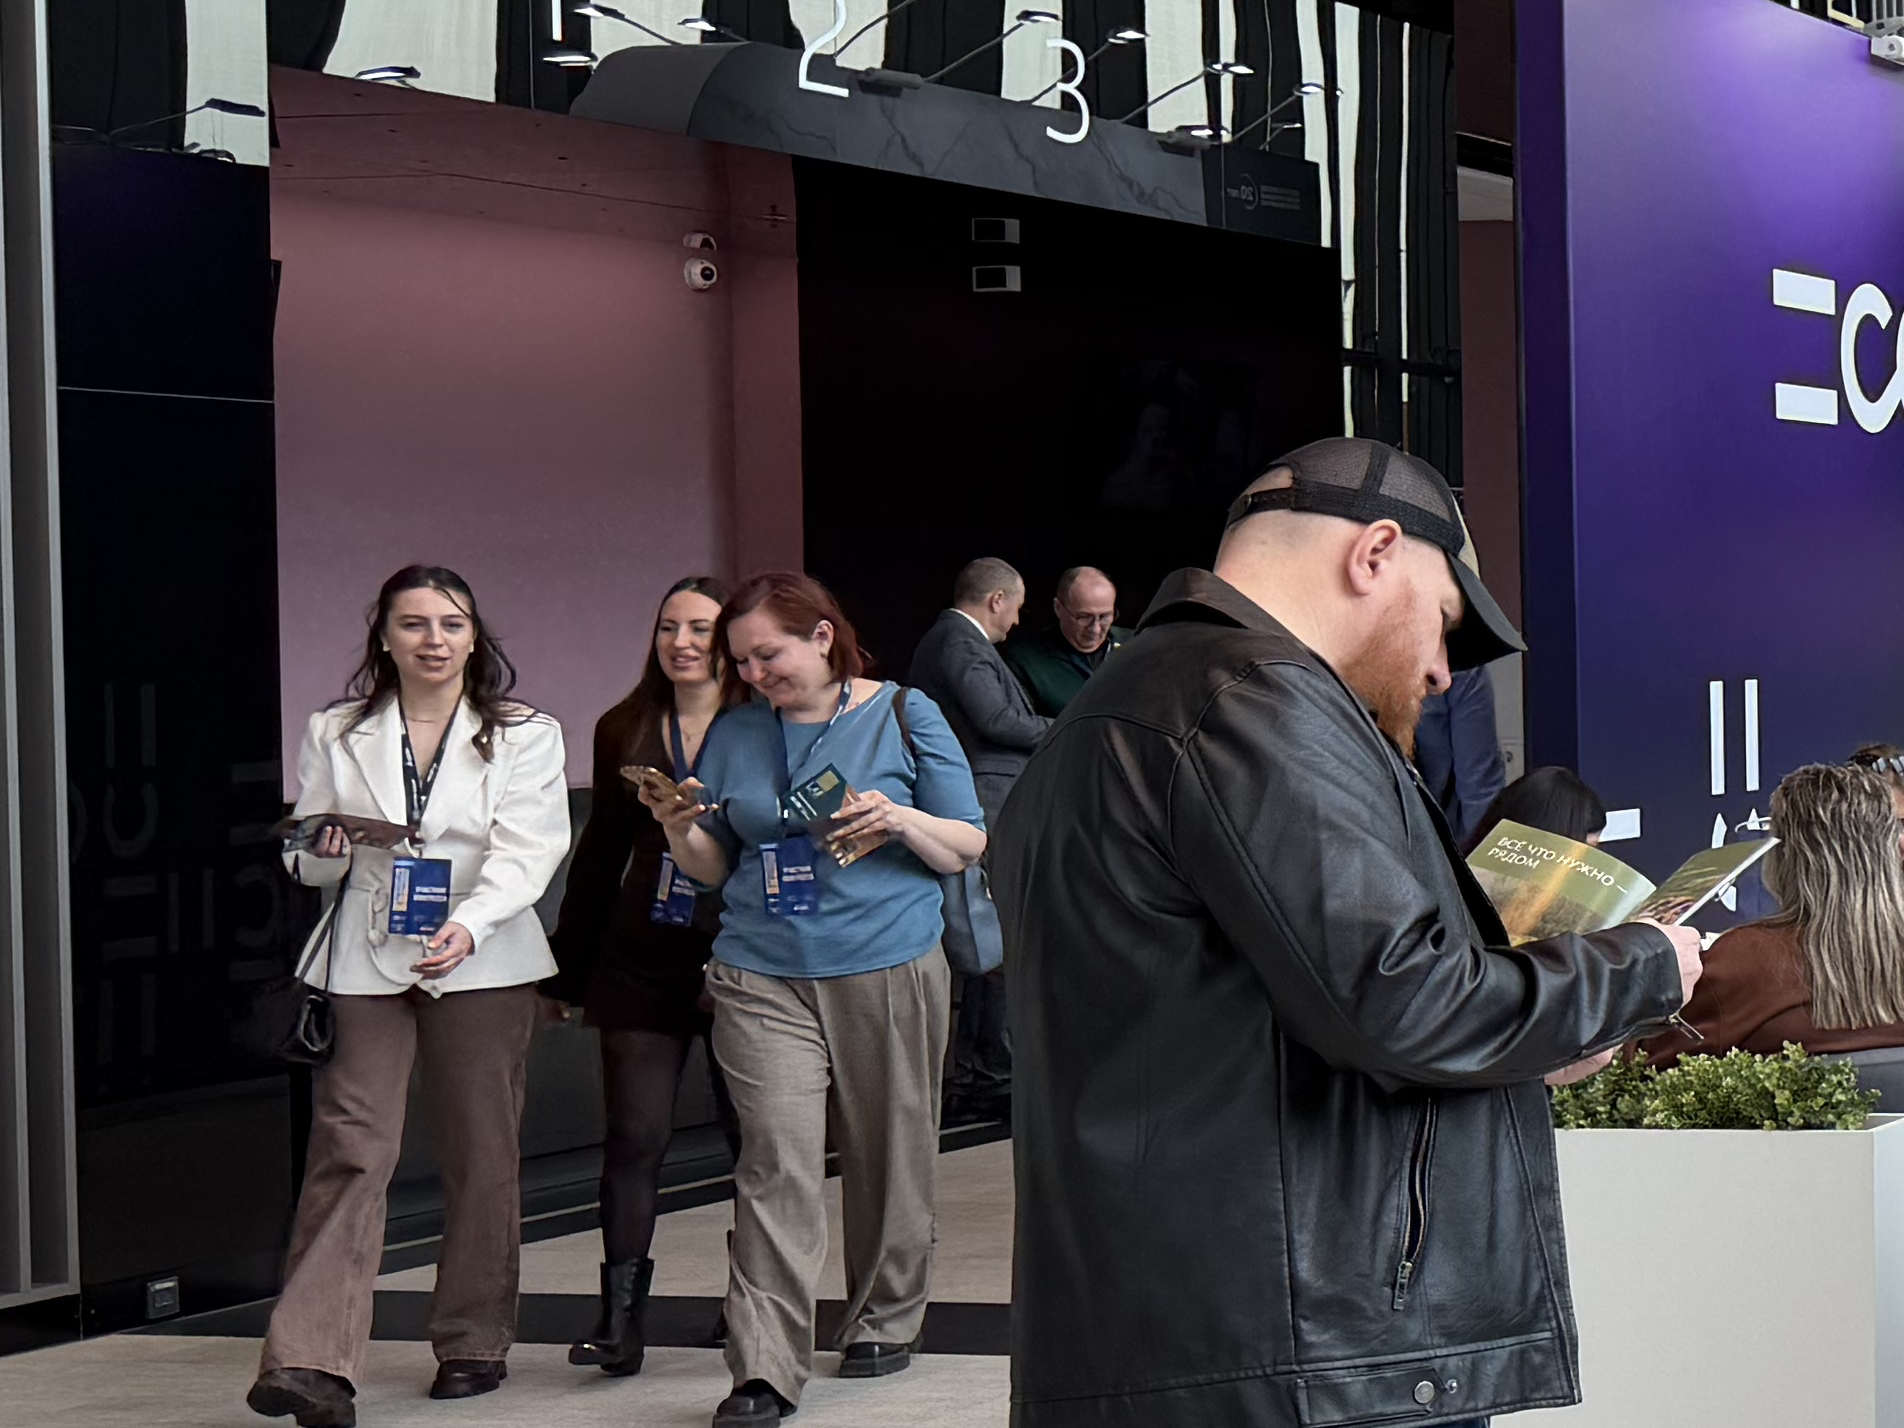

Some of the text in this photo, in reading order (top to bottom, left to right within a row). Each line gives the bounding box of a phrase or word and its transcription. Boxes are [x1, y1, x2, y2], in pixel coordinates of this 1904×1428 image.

[1046, 38, 1090, 144] 3
[1487, 846, 1540, 870] РЯДОМ
[1528, 844, 1556, 861] ЧТО
[1556, 854, 1615, 887] НУЖНО
